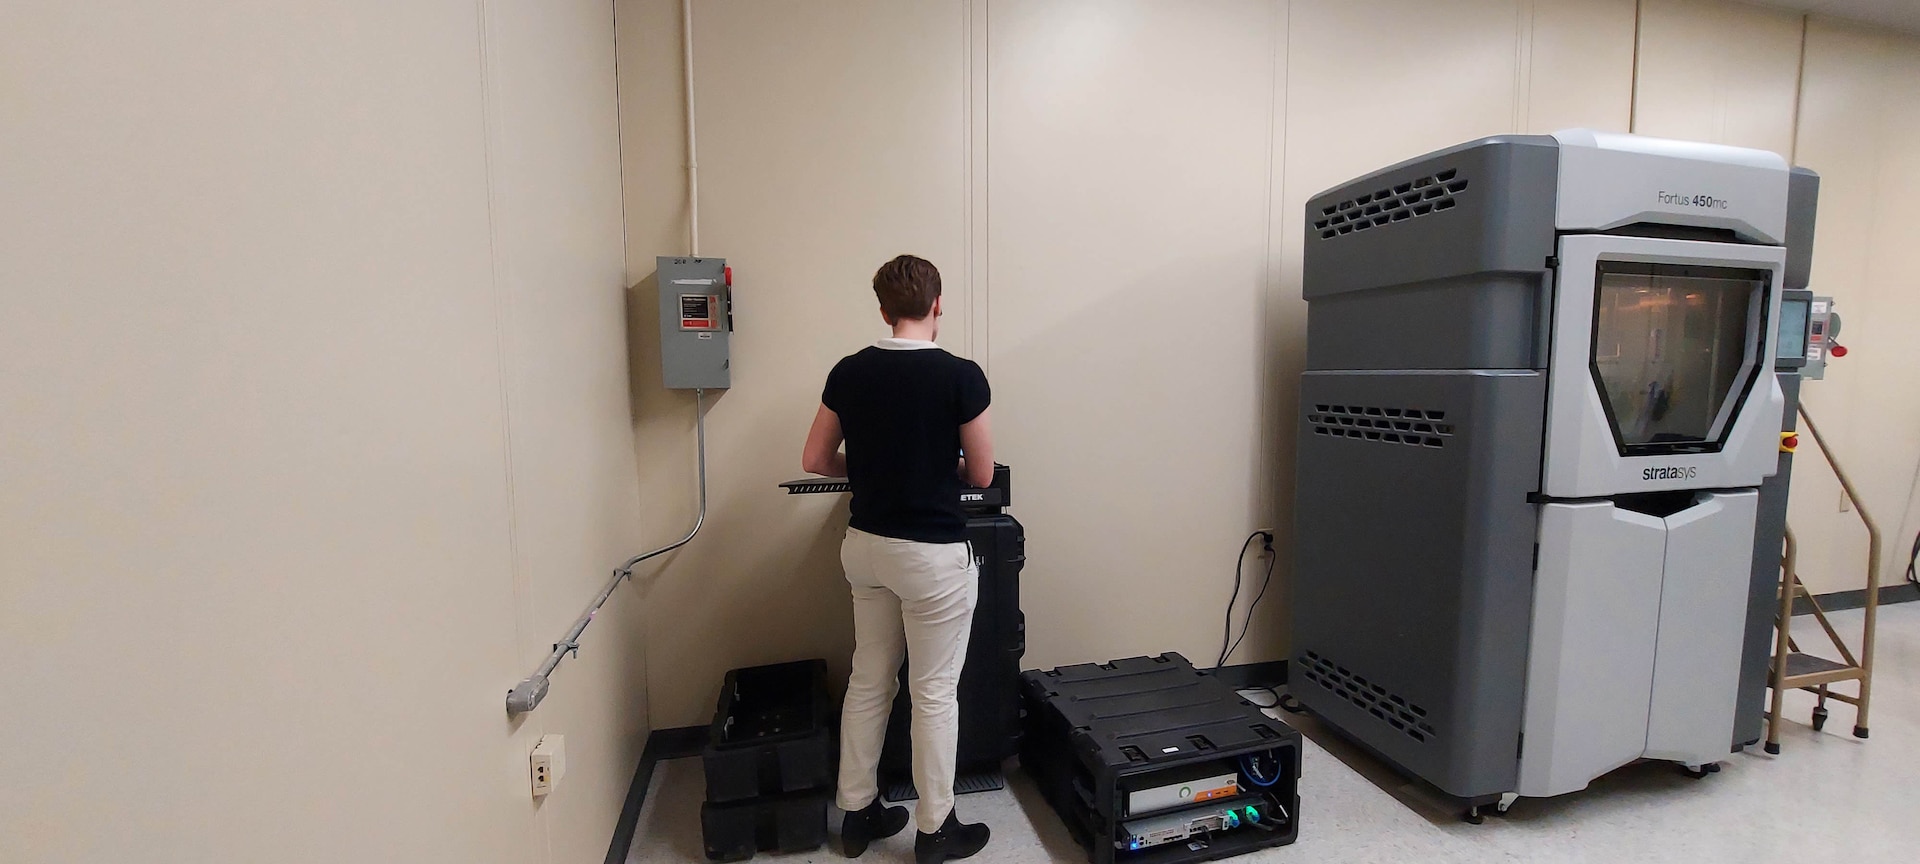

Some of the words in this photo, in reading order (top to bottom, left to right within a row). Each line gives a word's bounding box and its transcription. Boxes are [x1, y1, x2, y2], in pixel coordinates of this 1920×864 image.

[1658, 190, 1689, 206] Fortus
[1692, 194, 1727, 209] 450mc
[1642, 466, 1697, 481] stratasys
